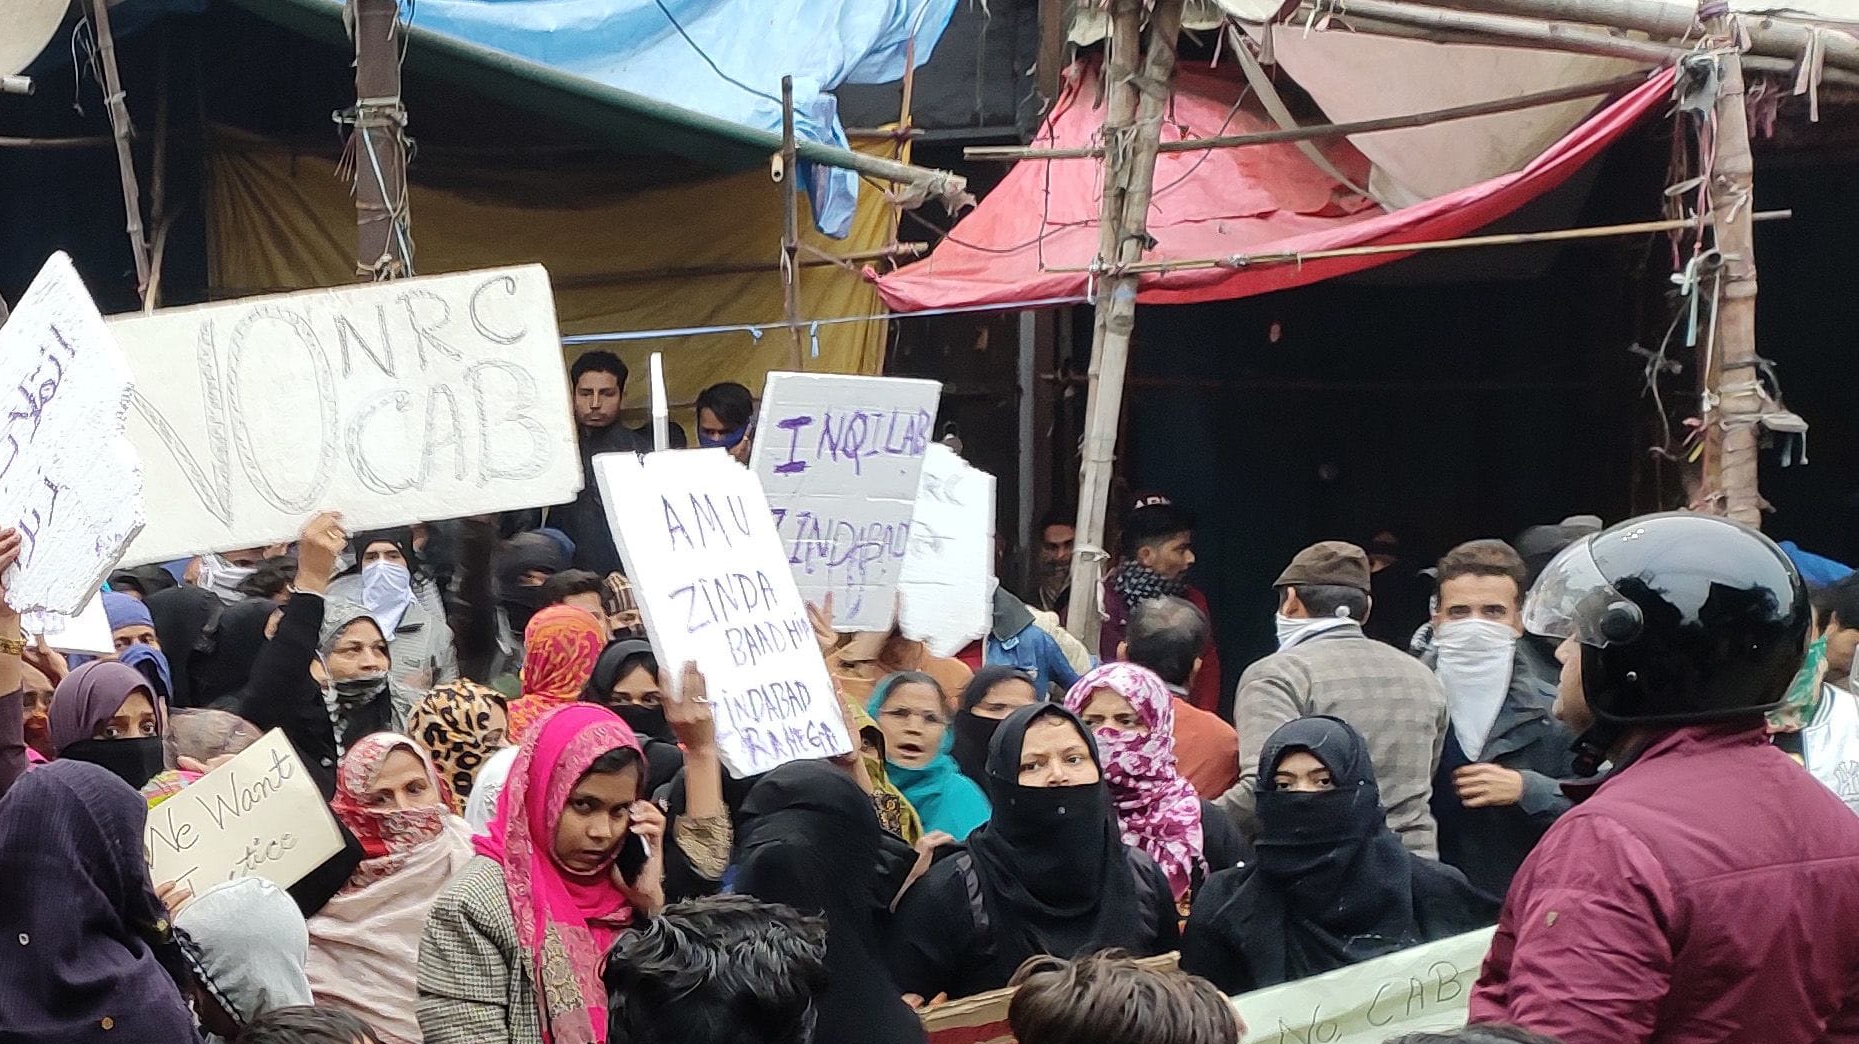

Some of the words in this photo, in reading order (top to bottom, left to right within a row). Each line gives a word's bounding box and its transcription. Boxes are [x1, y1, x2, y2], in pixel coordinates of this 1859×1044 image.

[332, 274, 528, 379] NRC
[343, 358, 552, 496] CAB
[660, 492, 751, 552] AMU
[195, 748, 297, 830] Want
[1366, 961, 1462, 1027] CAB
